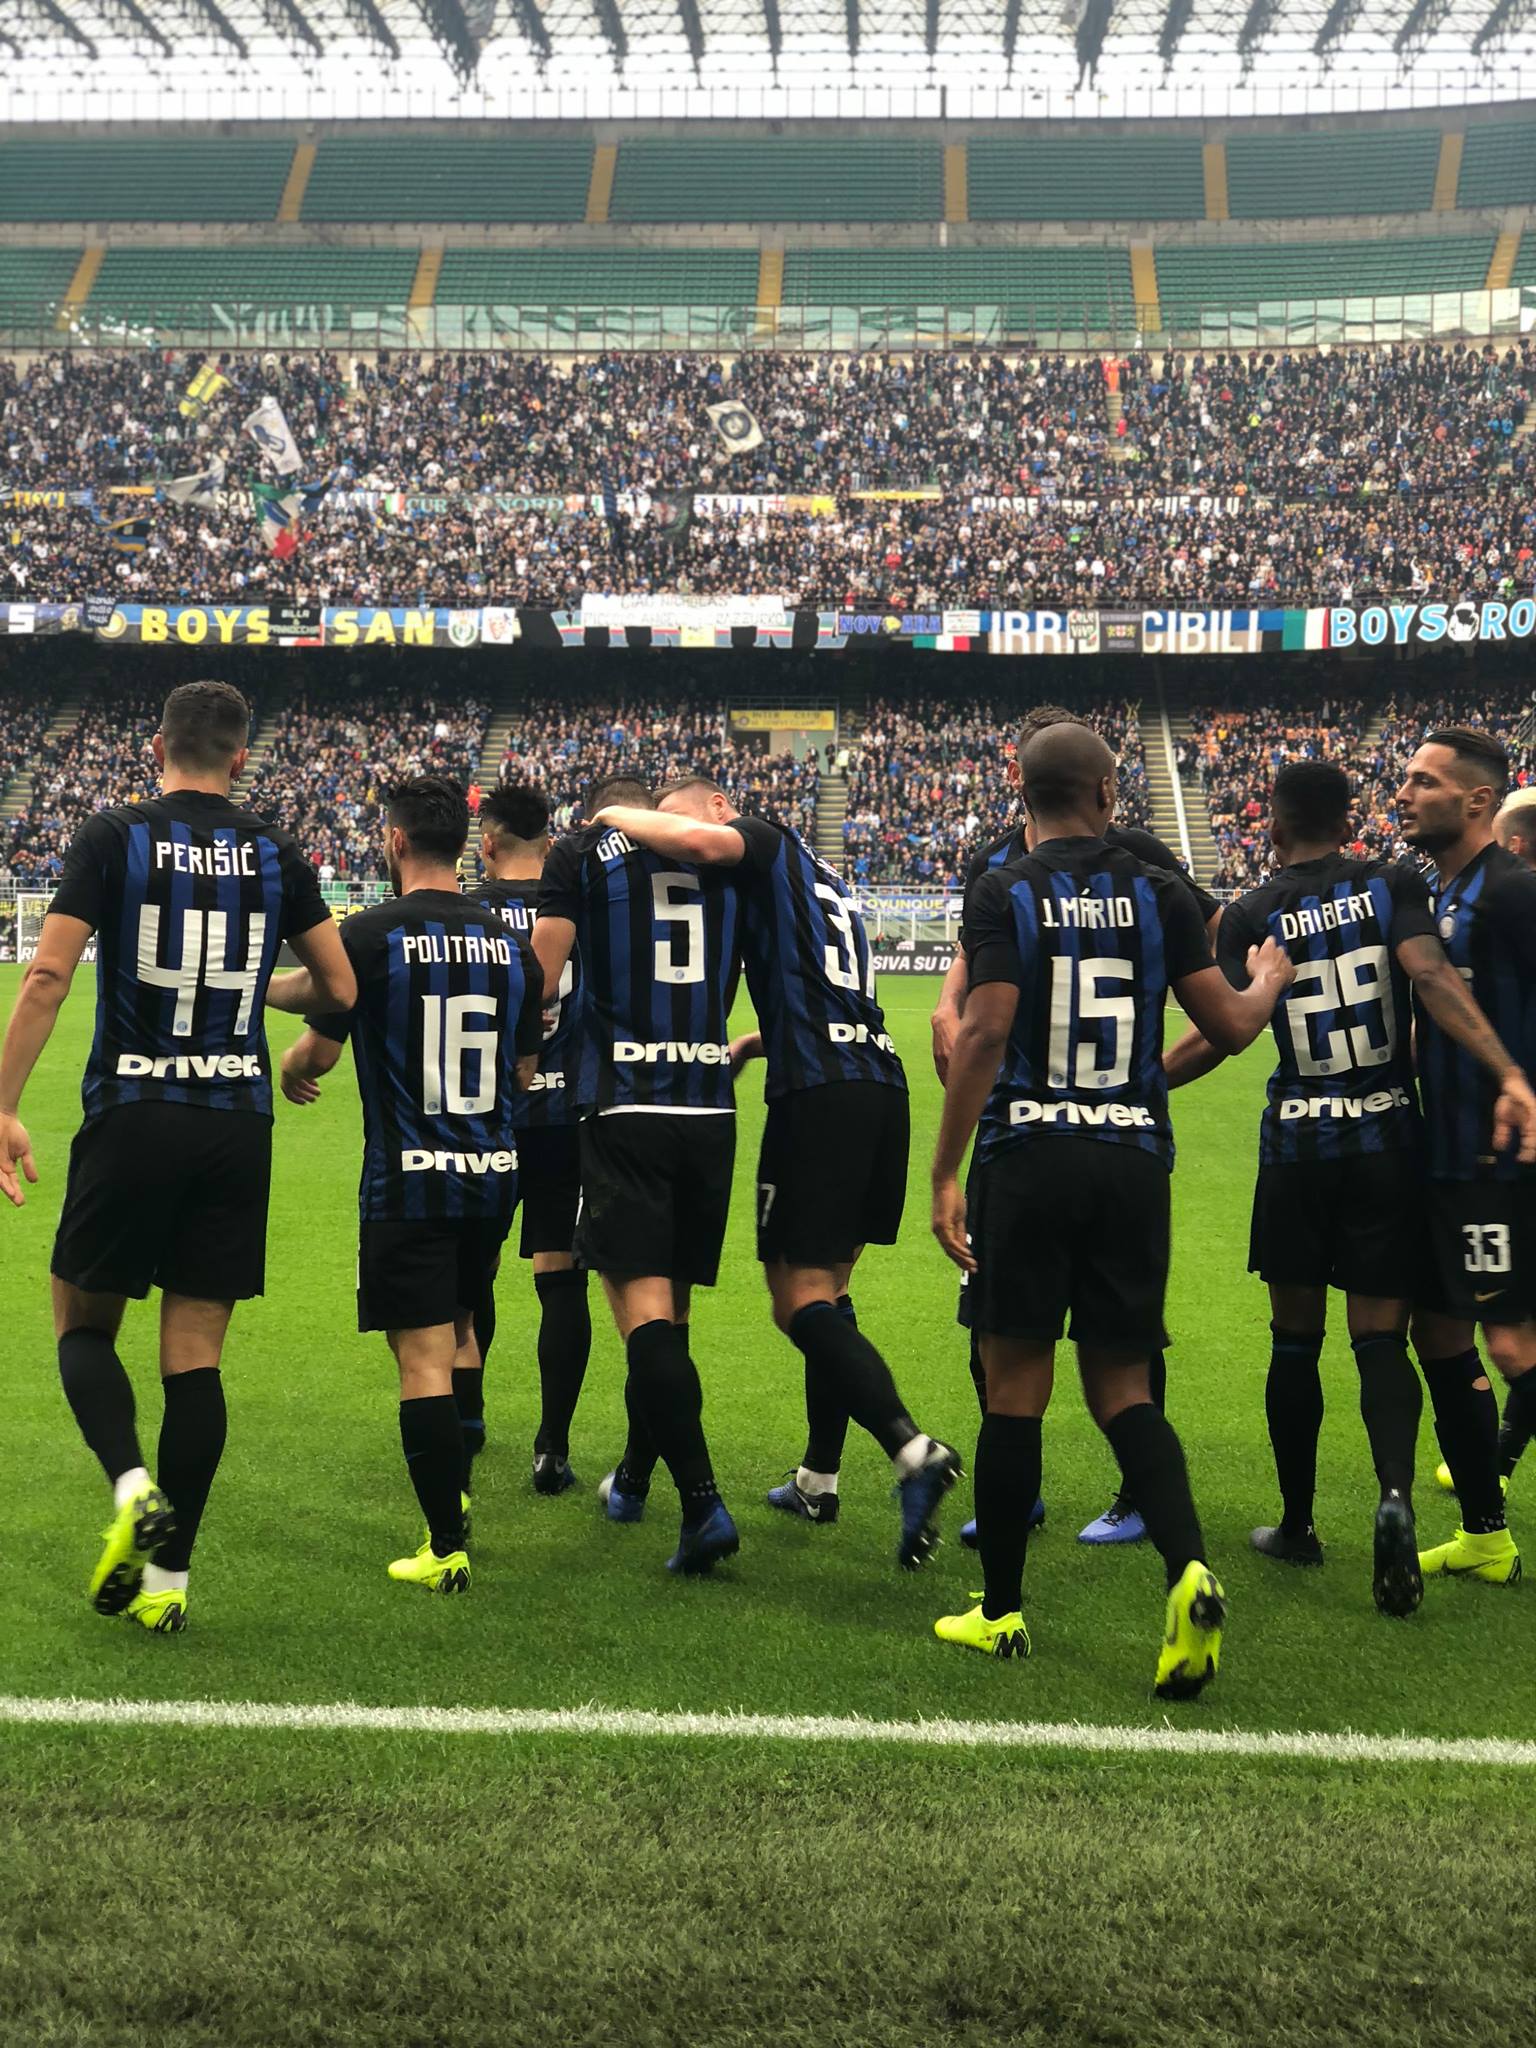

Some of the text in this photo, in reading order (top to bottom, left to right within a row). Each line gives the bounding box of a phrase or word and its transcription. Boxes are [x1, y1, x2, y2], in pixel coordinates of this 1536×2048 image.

[1199, 497, 1240, 518] BLU
[141, 608, 270, 644] BOYS
[333, 610, 435, 645] SAN
[1142, 610, 1262, 653] CIBILI
[1330, 604, 1449, 647] BOYS
[156, 839, 256, 876] PERIŠIĆ
[651, 871, 706, 984] 5
[137, 903, 267, 1037] 44
[402, 935, 512, 965] POLITANO
[913, 956, 938, 971] SU
[1047, 956, 1136, 1089] 15
[1286, 945, 1397, 1077] 29
[421, 994, 498, 1116] 16
[1461, 1223, 1512, 1273] 33
